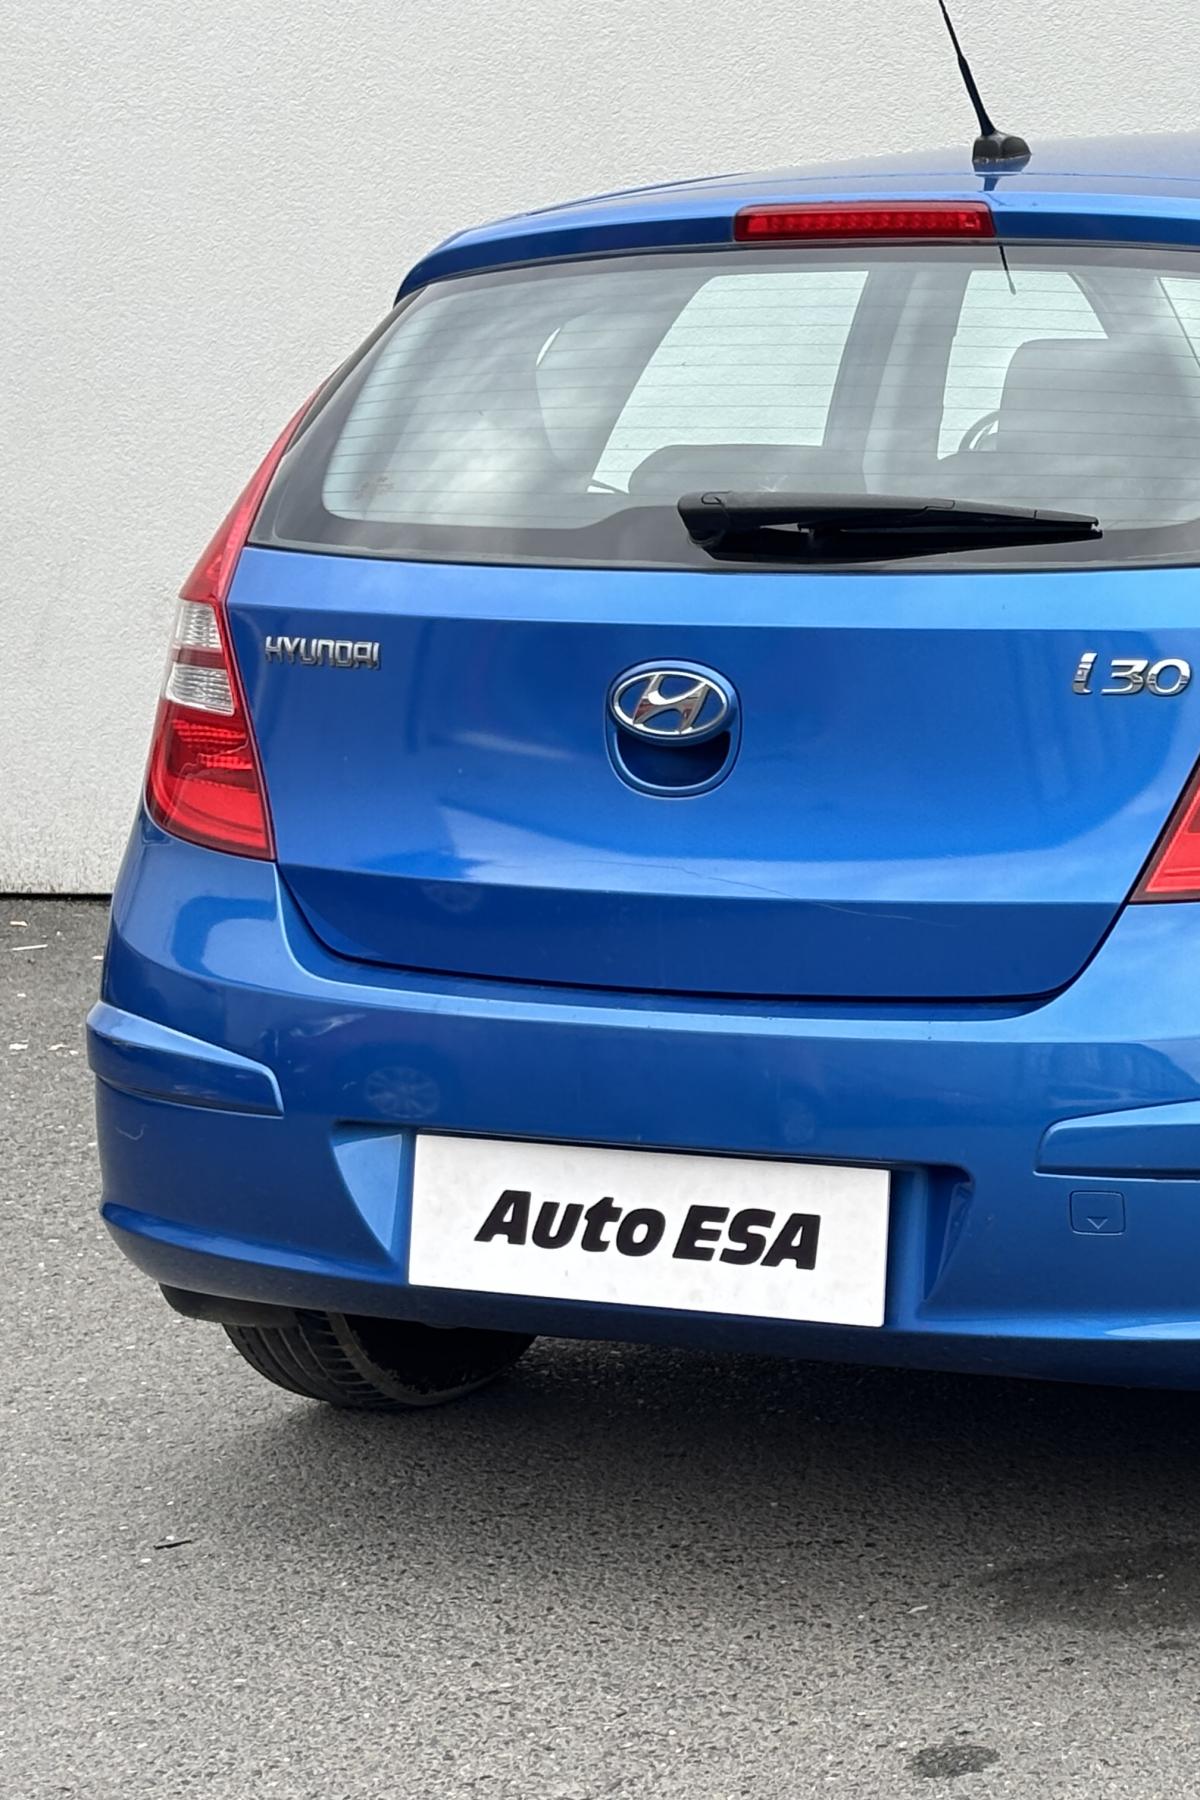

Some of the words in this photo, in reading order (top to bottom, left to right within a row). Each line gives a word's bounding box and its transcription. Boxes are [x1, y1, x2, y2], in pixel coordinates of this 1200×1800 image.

[265, 636, 381, 670] HYUNDAI
[474, 1190, 666, 1257] Auto
[672, 1205, 821, 1271] ESA
